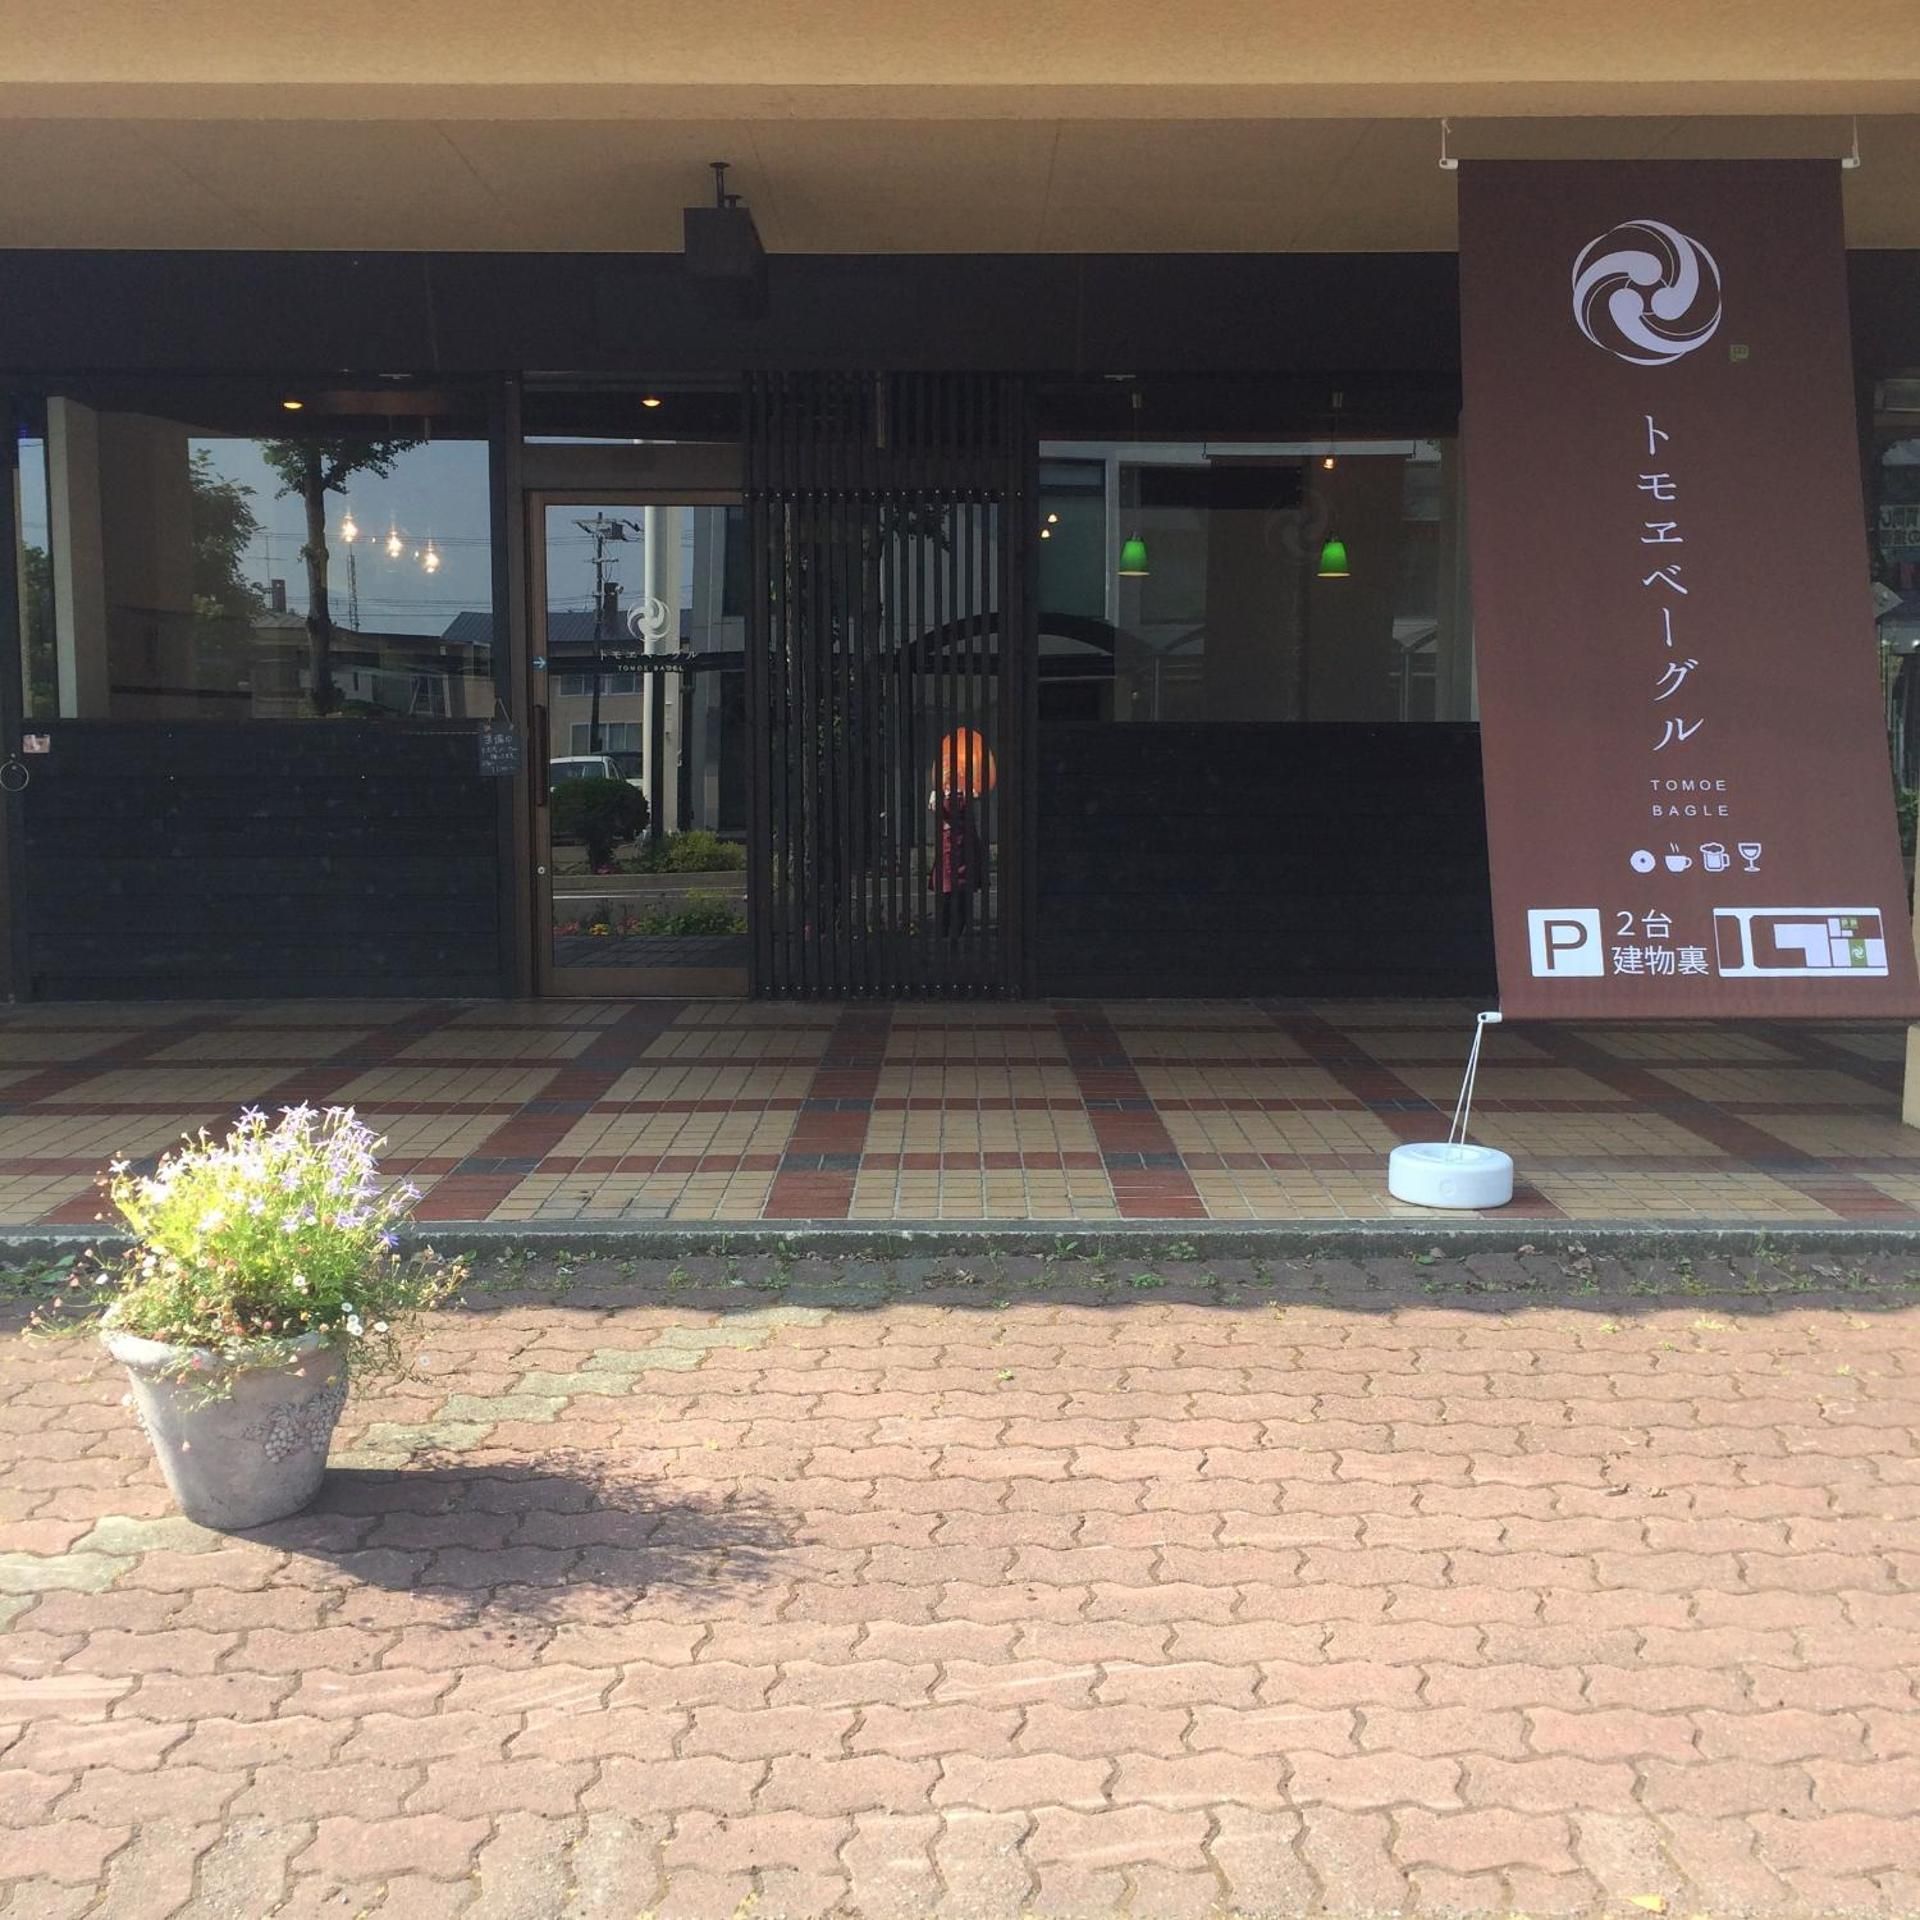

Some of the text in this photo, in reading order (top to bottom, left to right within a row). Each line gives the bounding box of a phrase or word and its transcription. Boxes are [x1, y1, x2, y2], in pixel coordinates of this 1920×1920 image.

[1637, 415, 1704, 751] トモヱベーグル
[1650, 779, 1727, 791] TOMOE
[1652, 804, 1729, 817] BAGLE
[1616, 909, 1673, 939] 2台
[1543, 919, 1588, 970] P
[1611, 945, 1709, 976] 建物裏
